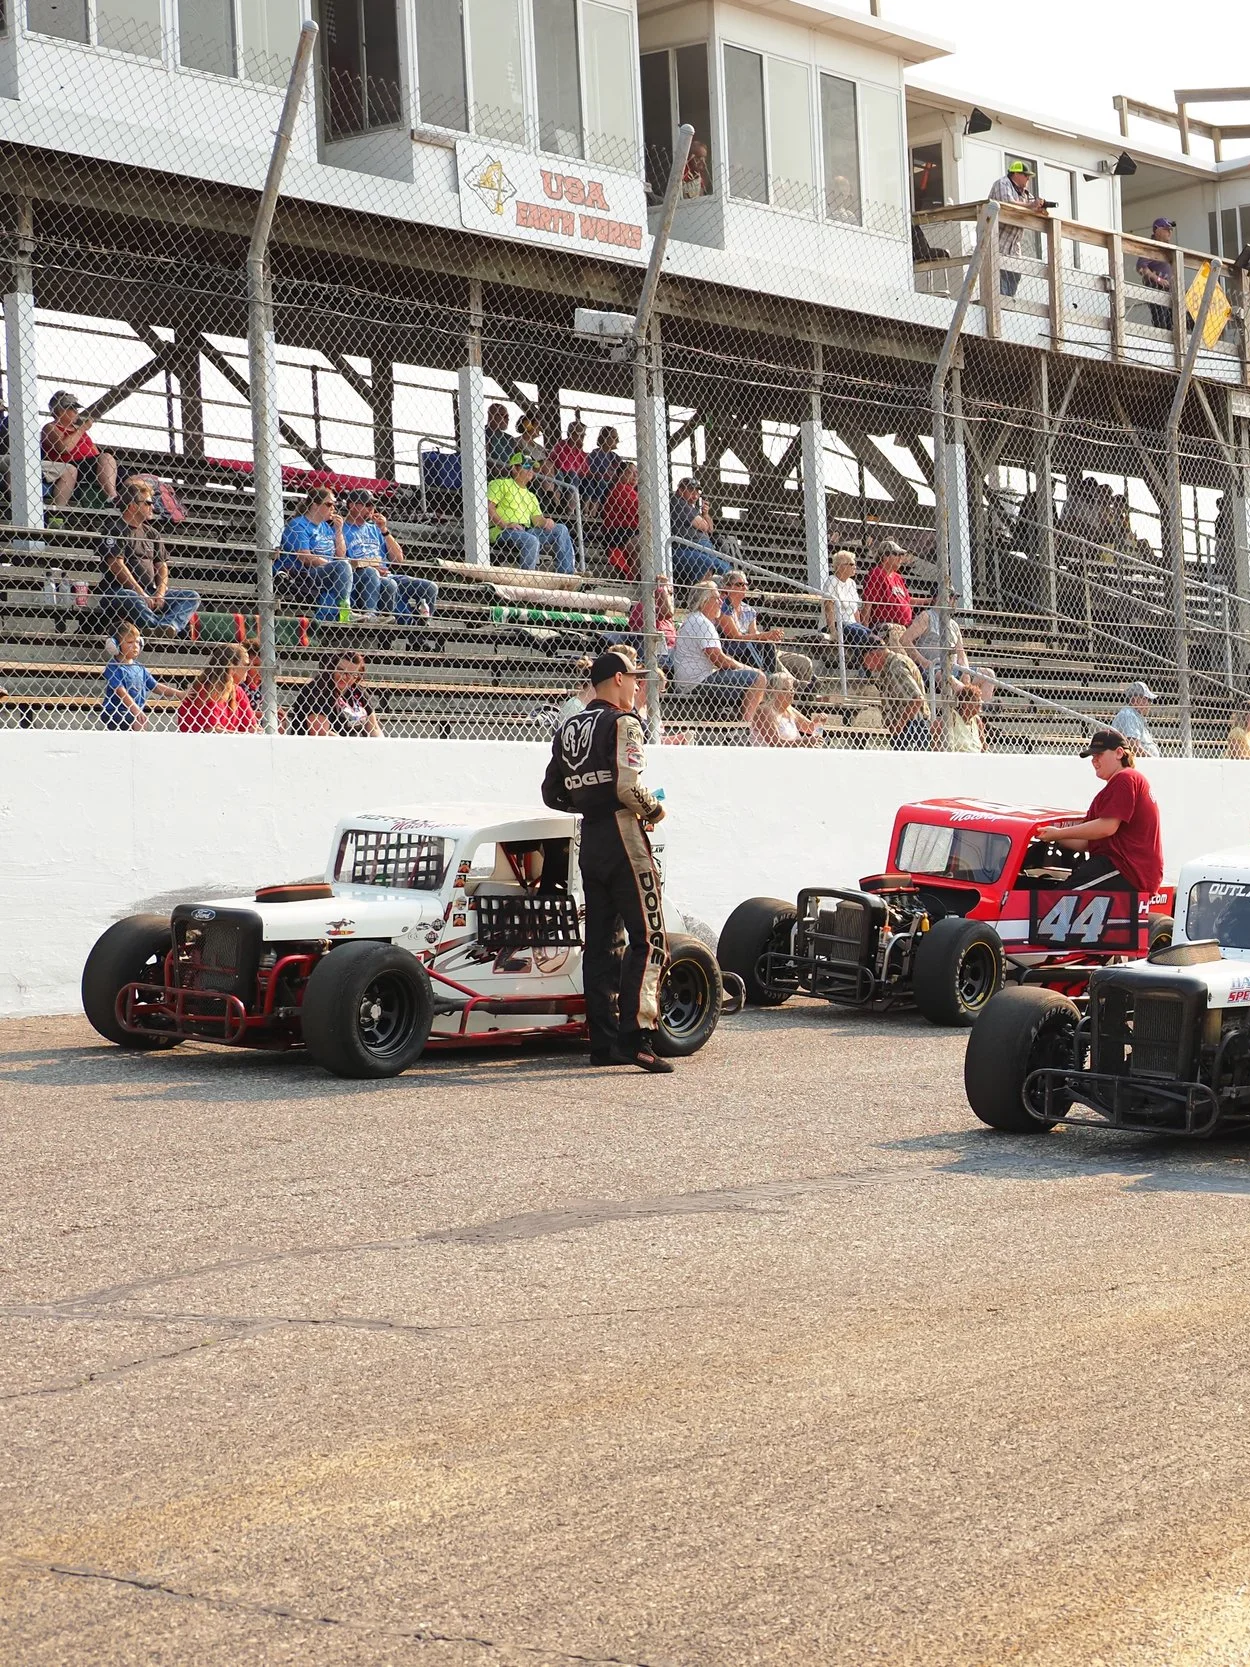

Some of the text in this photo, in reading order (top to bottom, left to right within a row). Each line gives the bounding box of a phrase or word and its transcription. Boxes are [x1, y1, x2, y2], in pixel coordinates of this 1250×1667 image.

[540, 169, 610, 212] USA
[515, 201, 643, 250] EARTH WORKS
[564, 769, 613, 791] ODGE
[193, 908, 214, 920] Ford
[638, 871, 666, 967] DODGE
[1037, 894, 1112, 944] 44
